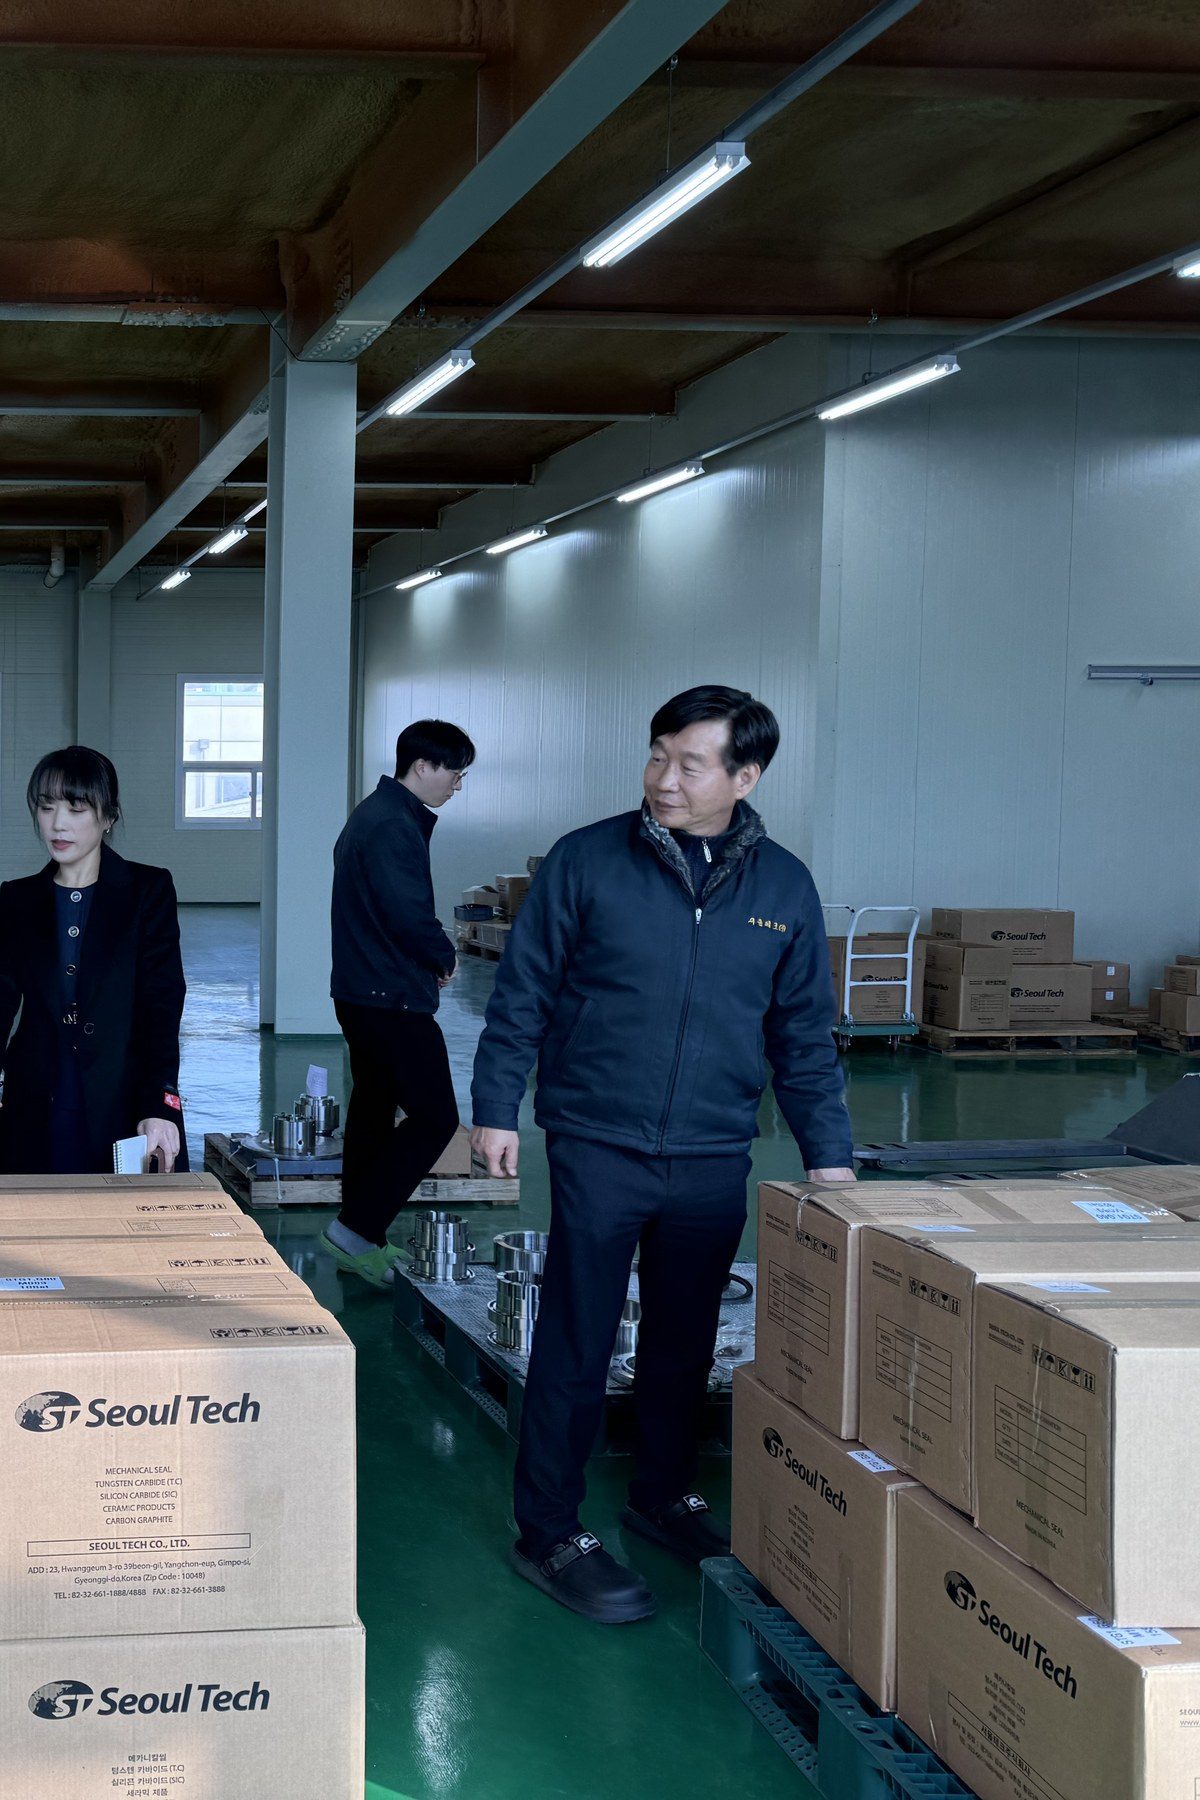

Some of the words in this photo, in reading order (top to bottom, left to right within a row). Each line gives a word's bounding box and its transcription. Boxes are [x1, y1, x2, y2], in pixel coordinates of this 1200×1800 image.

[1006, 932, 1028, 941] Seoul
[1029, 932, 1046, 940] Tech
[1024, 989, 1046, 998] Seoul
[1047, 989, 1065, 998] Tech
[85, 1394, 181, 1429] Seoul
[186, 1392, 261, 1425] Tech
[105, 1467, 153, 1475] MECHANICAL
[154, 1466, 172, 1474] SEAL
[95, 1480, 134, 1488] TUNGSTEN
[134, 1479, 166, 1487] CARBIDE
[784, 1447, 818, 1490] Seoul
[818, 1473, 848, 1517] Tech
[100, 1492, 128, 1500] SILICON
[129, 1491, 160, 1499] CARBIDE
[102, 1504, 135, 1512] CERAMIC
[136, 1503, 176, 1511] PRODUCTS
[105, 1517, 137, 1525] CARBON
[137, 1516, 173, 1524] GRAPHITE
[89, 1541, 122, 1551] SEOUL
[123, 1540, 147, 1550] TECH
[149, 1540, 168, 1550] CO.,
[169, 1539, 190, 1548] LTD.
[27, 1566, 45, 1574] ADD
[49, 1566, 60, 1574] 23,
[61, 1564, 107, 1574] Hwanggeum
[108, 1563, 122, 1571] 3-ro
[164, 1560, 216, 1570] Yangchon-eup,
[158, 1573, 177, 1581] Code
[54, 1592, 67, 1600] TEL
[71, 1589, 147, 1599] 82-32-661-1888/4888
[170, 1585, 226, 1595] 82-32-661-3888
[978, 1600, 1032, 1661] Seoul
[1031, 1640, 1079, 1699] Tech
[97, 1683, 193, 1716] Seoul
[197, 1681, 271, 1712] Tech
